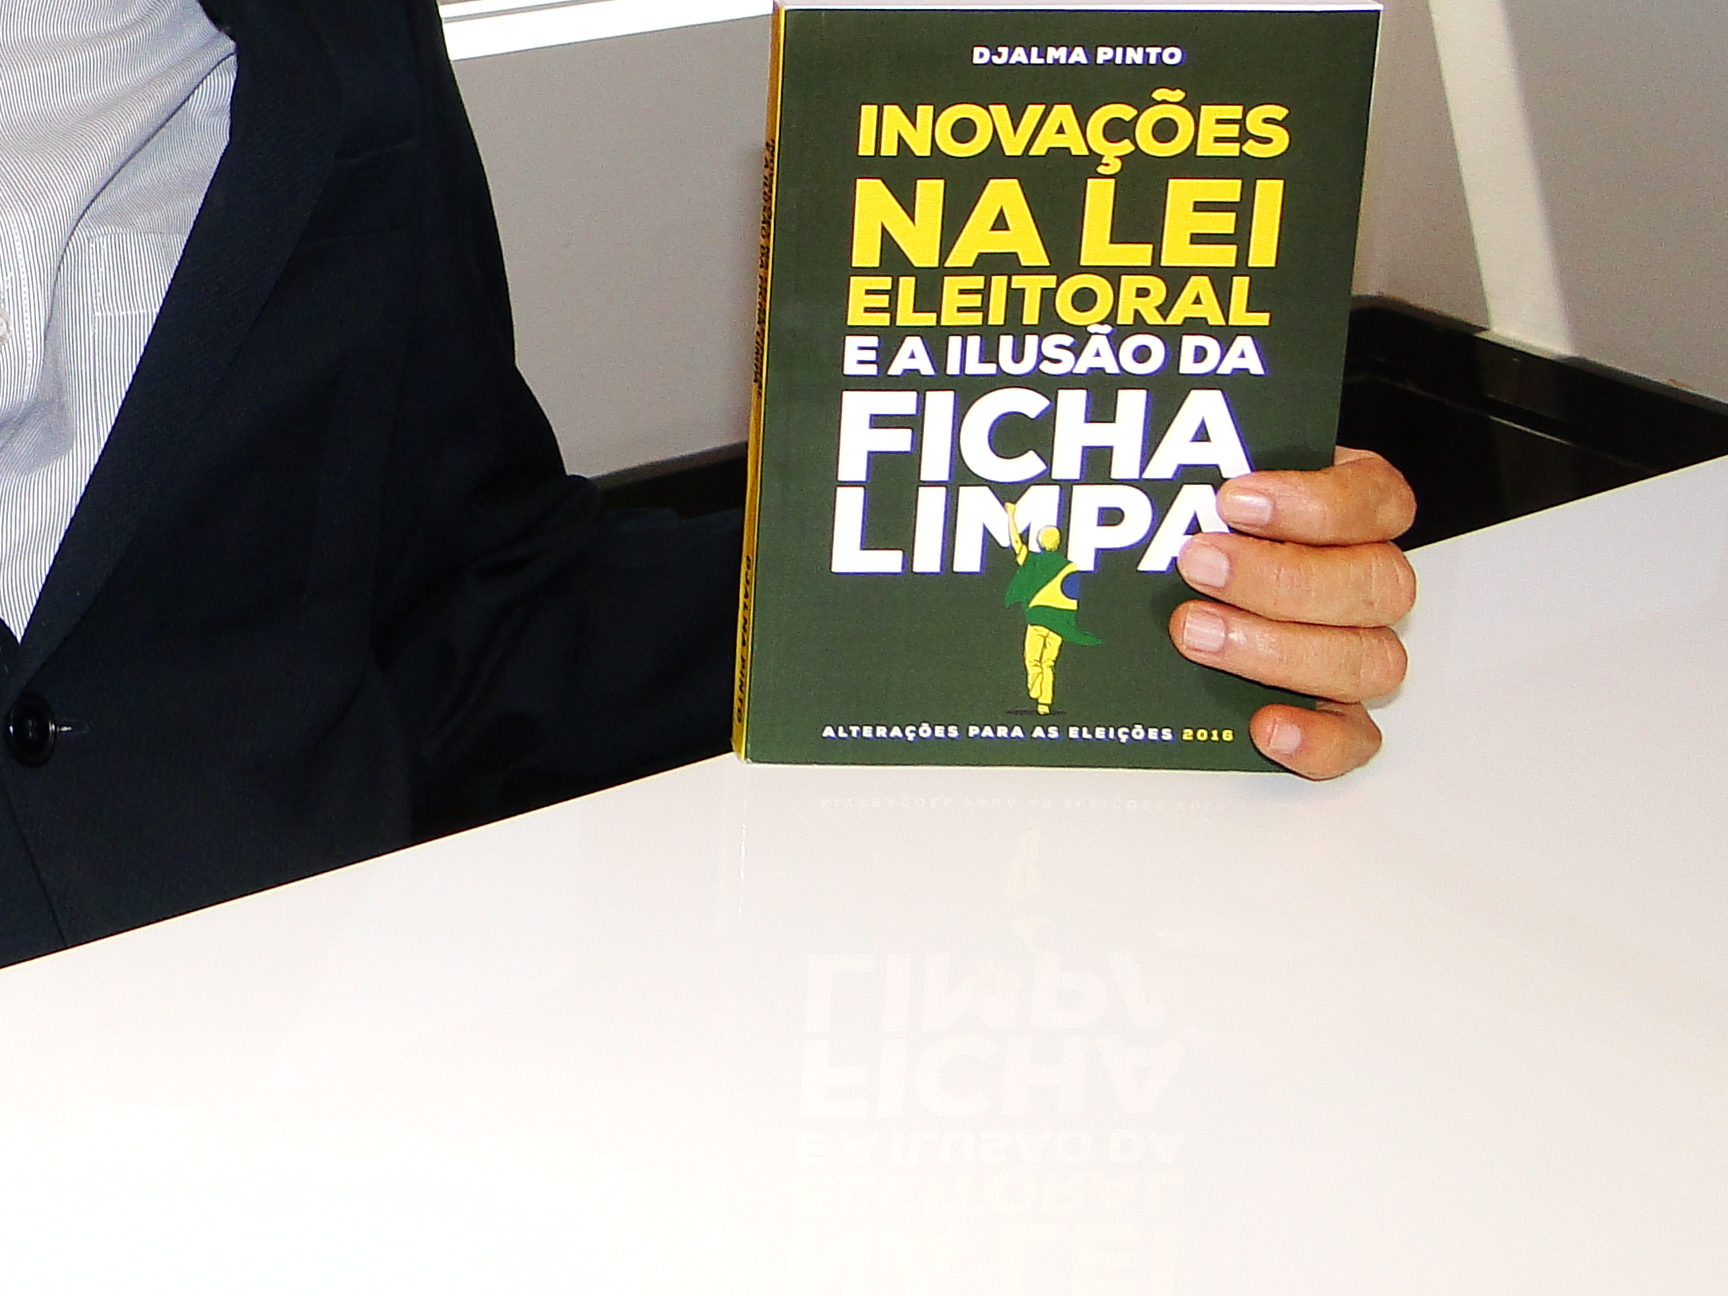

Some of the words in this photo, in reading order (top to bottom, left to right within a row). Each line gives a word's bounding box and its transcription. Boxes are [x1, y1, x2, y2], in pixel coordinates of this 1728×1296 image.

[973, 46, 1088, 65] DJALMA
[1096, 46, 1182, 65] PINTO
[857, 87, 1290, 175] INOVAÇÕES
[851, 178, 1050, 268] NA
[1079, 177, 1285, 268] LEI
[846, 273, 1271, 327] ELEITORAL
[843, 335, 879, 376] E
[887, 335, 936, 376] A
[945, 324, 1166, 375] ILUSÃO
[1178, 334, 1266, 375] DA
[837, 387, 1252, 483] FICHA
[821, 722, 959, 741] ALTERAÇÕES
[968, 725, 1025, 739] PARA
[1031, 726, 1060, 740] AS
[1068, 724, 1174, 743] ELEIÇÕES
[1182, 728, 1234, 742] 2016
